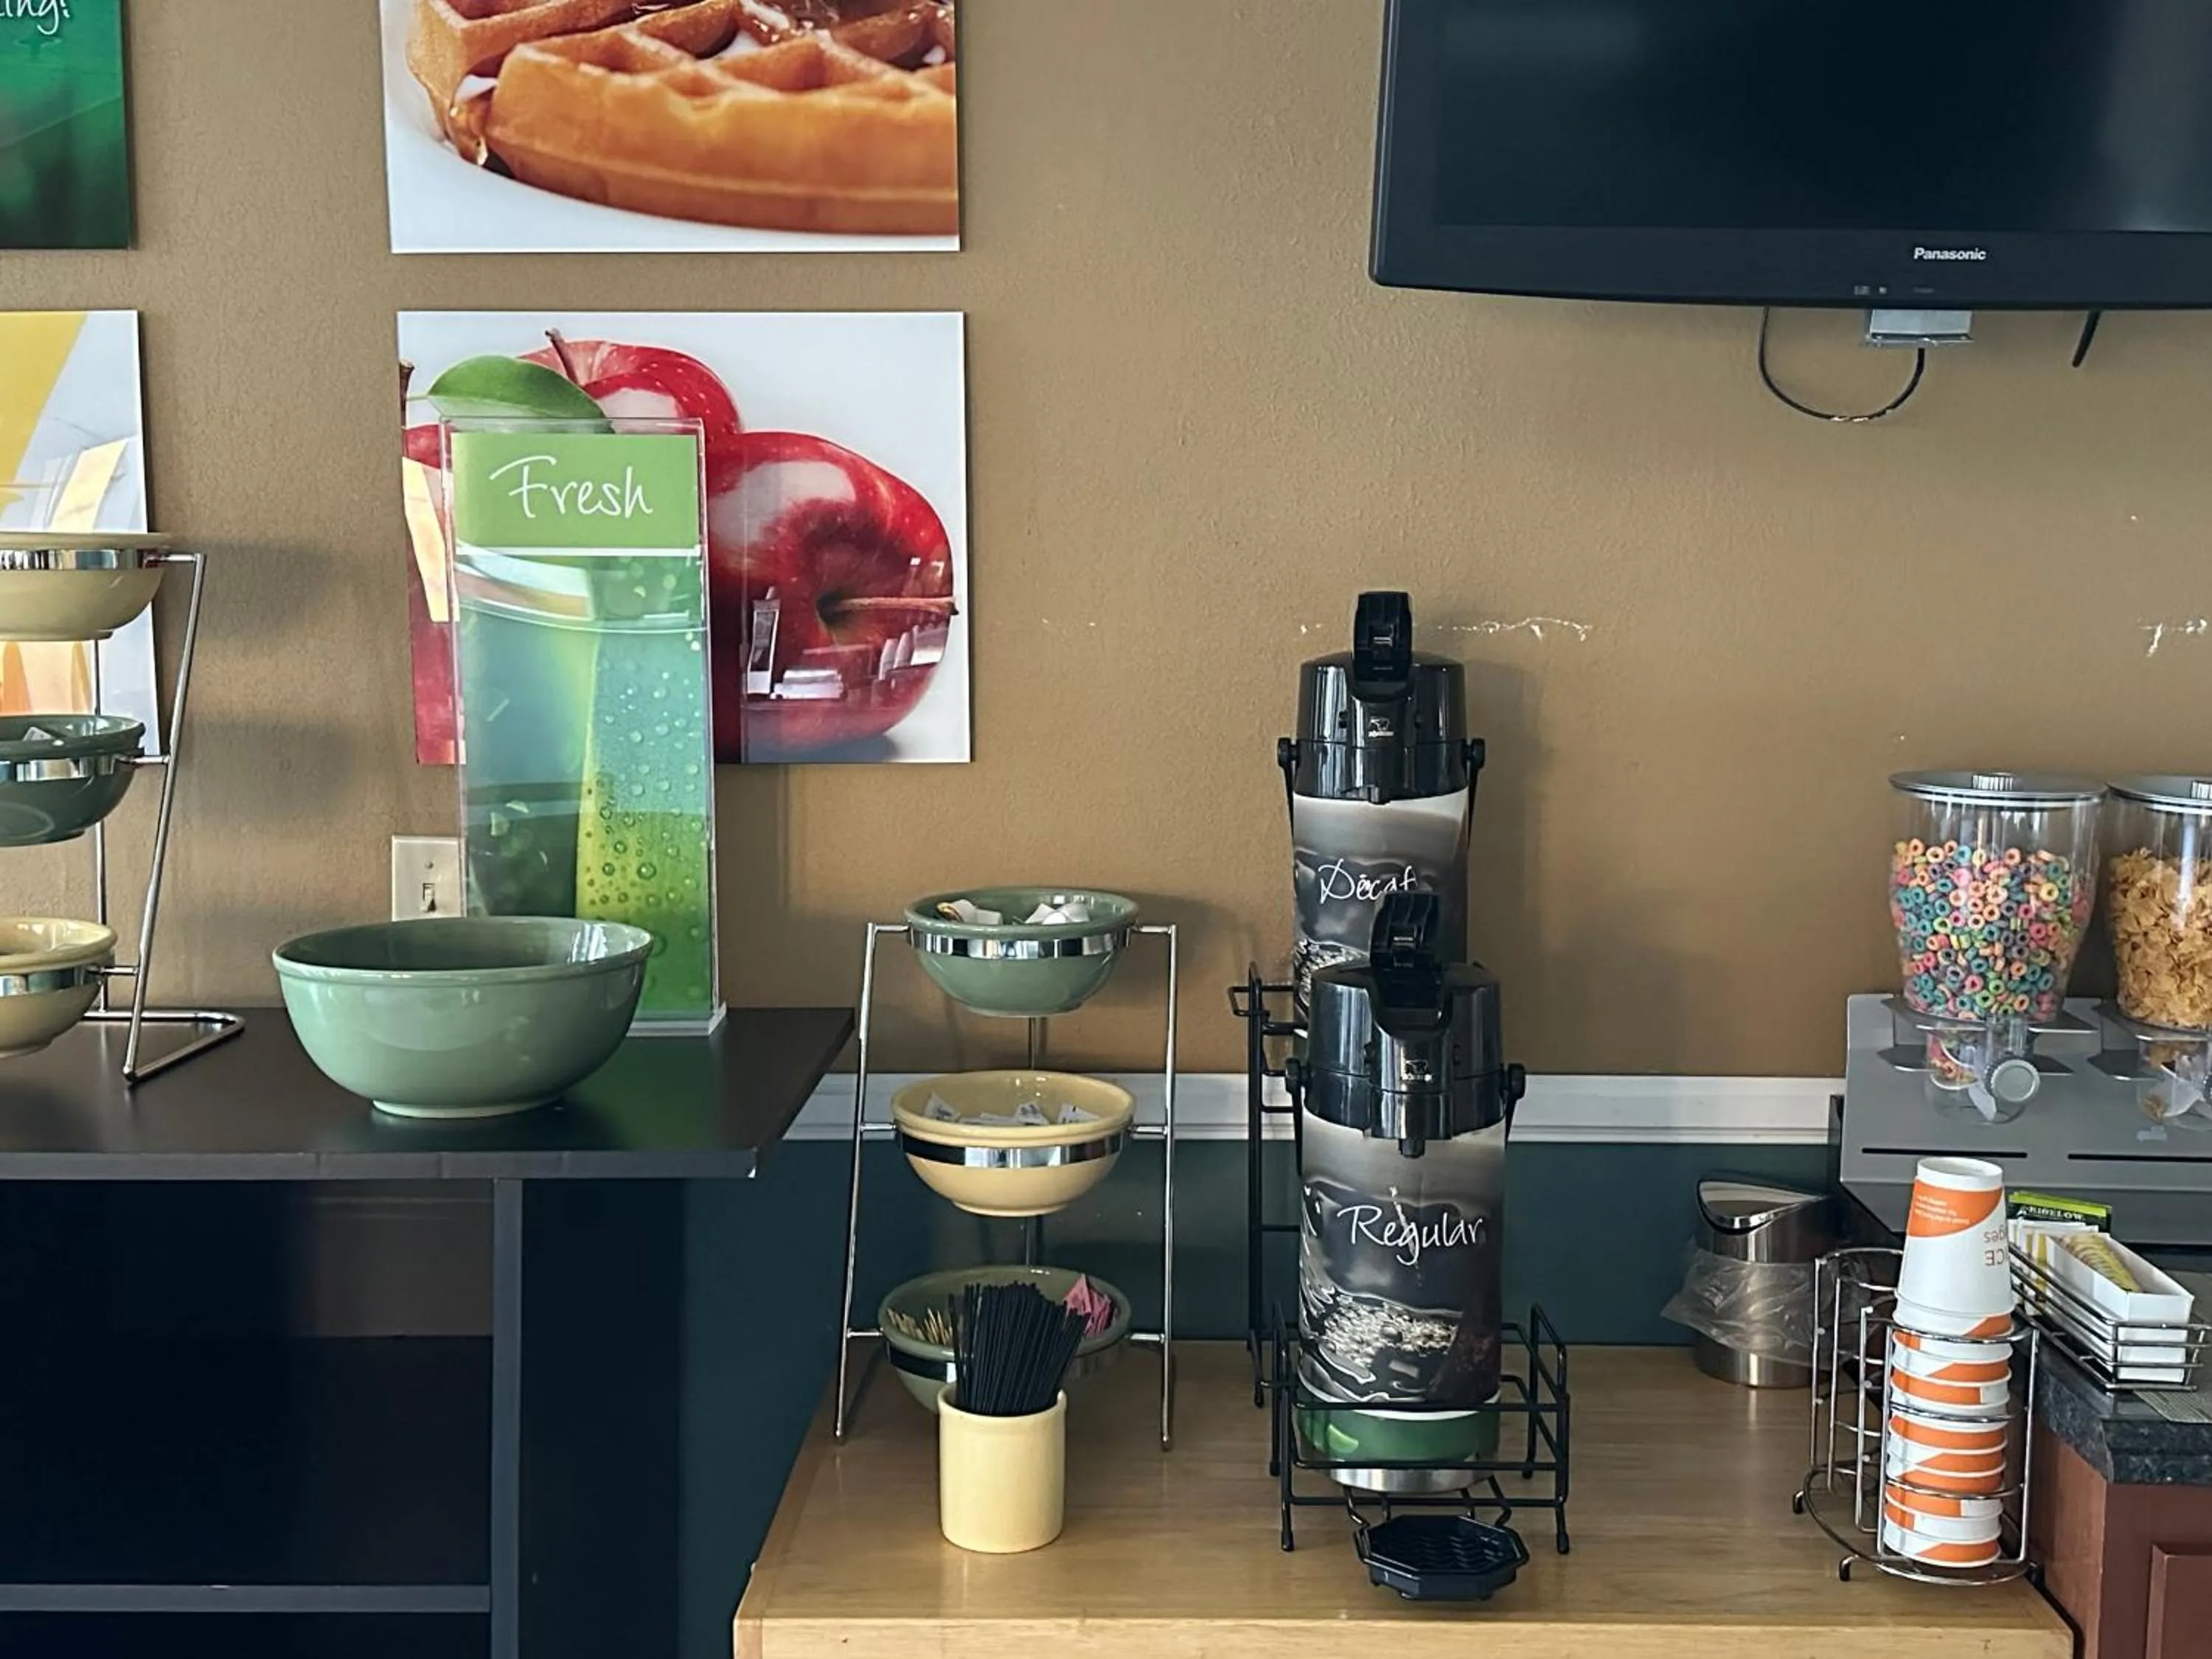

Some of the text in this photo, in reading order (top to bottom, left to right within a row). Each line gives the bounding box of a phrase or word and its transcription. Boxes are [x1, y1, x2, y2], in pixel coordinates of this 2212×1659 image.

[1913, 247, 1986, 260] Panasonic
[489, 454, 653, 518] Fresh
[1337, 1204, 1483, 1266] Regular
